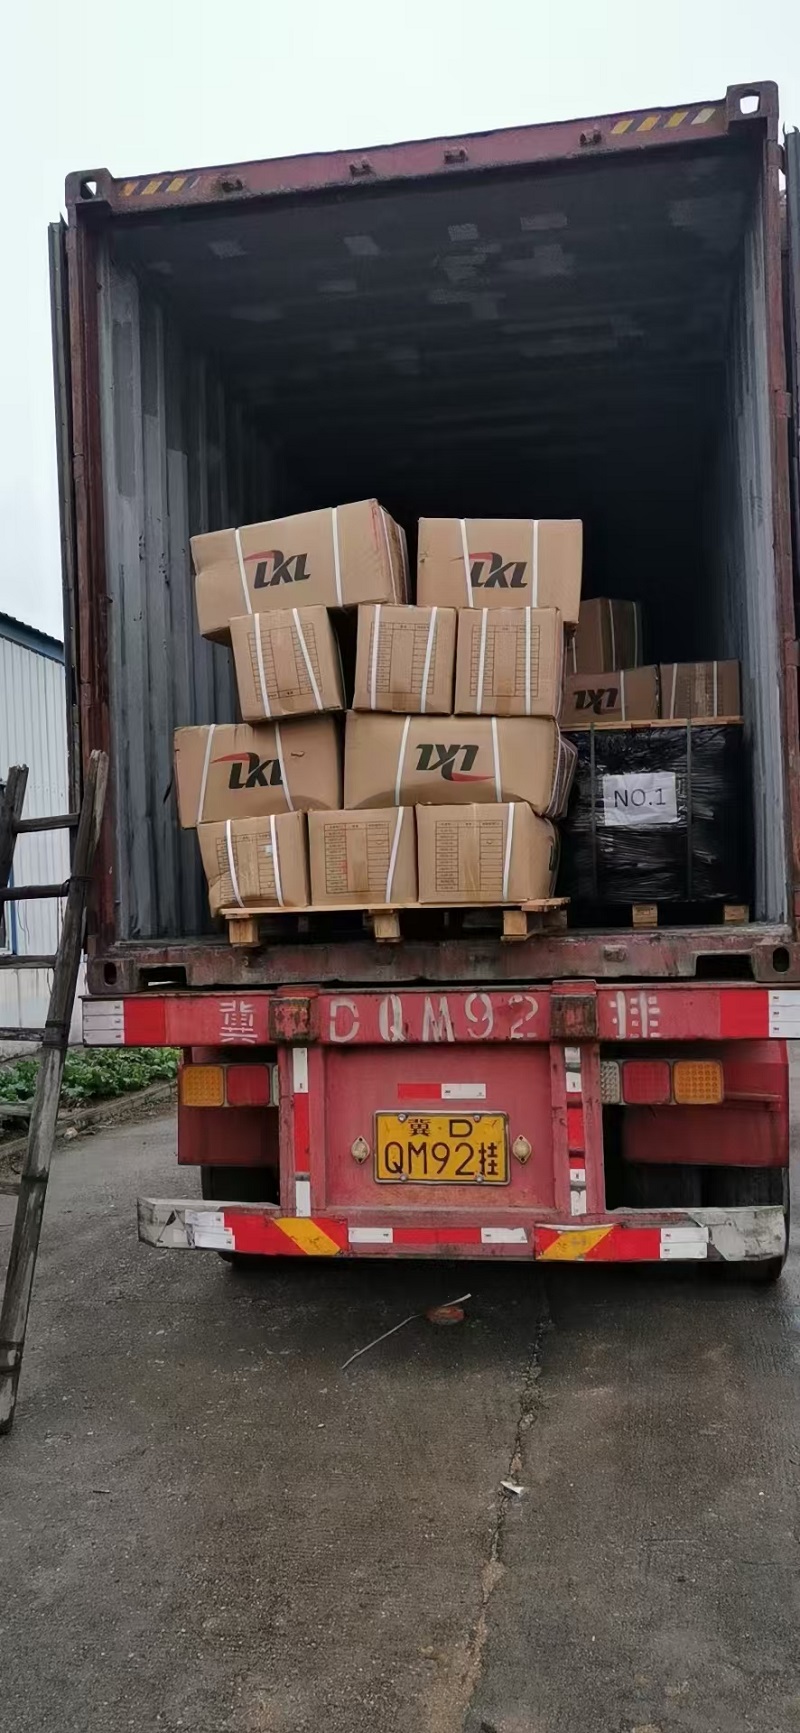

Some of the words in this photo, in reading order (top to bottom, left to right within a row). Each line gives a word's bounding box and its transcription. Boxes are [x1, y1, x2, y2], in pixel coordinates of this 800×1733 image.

[252, 549, 312, 590] LKL
[469, 552, 528, 588] LKL
[416, 743, 480, 781] LKL
[613, 788, 667, 808] NO.1
[219, 999, 258, 1043] 冀
[384, 1141, 499, 1176] QM92挂
